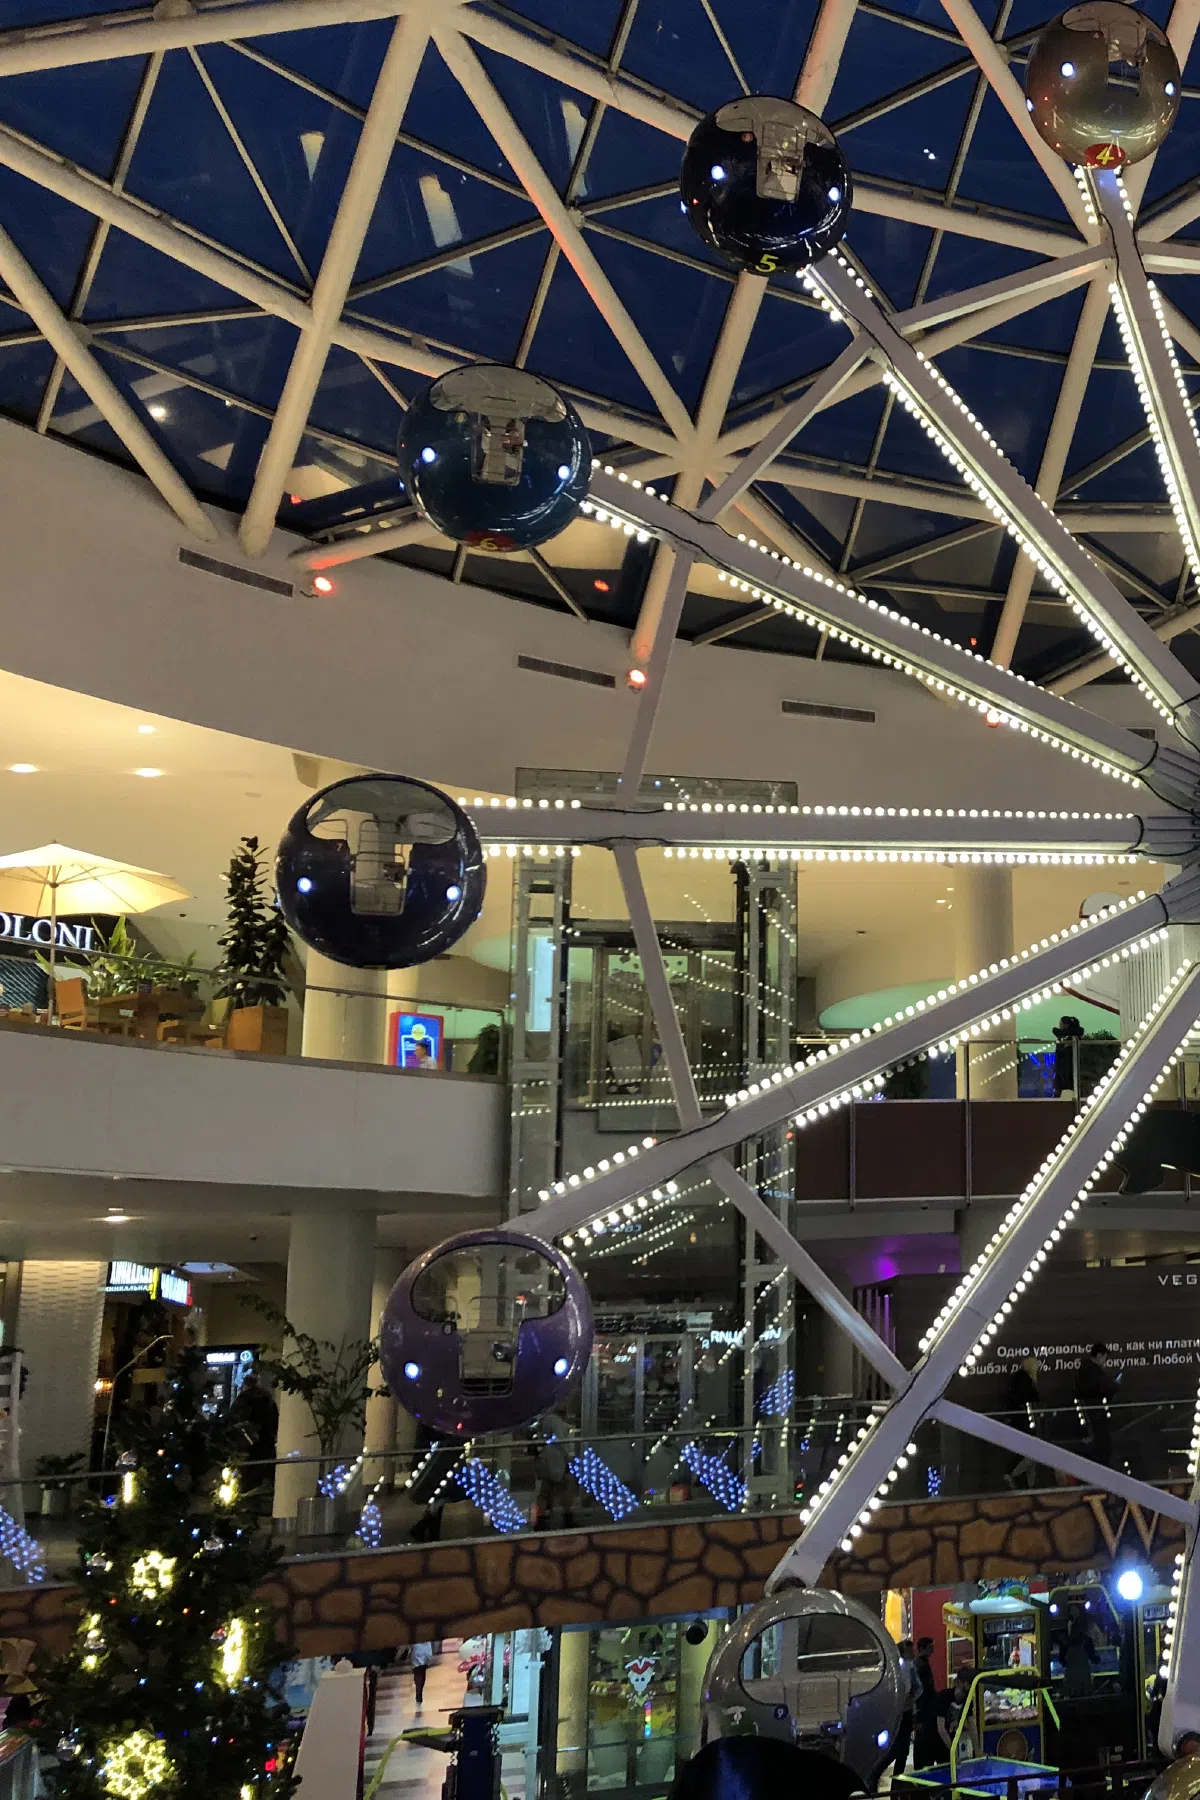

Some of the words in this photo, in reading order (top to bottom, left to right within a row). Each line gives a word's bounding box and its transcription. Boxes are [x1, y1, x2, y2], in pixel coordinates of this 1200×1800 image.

[1096, 147, 1115, 165] 4
[755, 254, 778, 272] 5
[997, 1346, 1030, 1358] Одно
[1033, 1342, 1123, 1357] удовольсие,
[1126, 1341, 1145, 1351] как
[1148, 1340, 1163, 1349] ни
[966, 1362, 1008, 1375] эшбэк
[1010, 1364, 1022, 1374] д
[1055, 1358, 1081, 1370] Люб
[1103, 1356, 1149, 1369] окупка.
[1152, 1353, 1193, 1365] Любой
